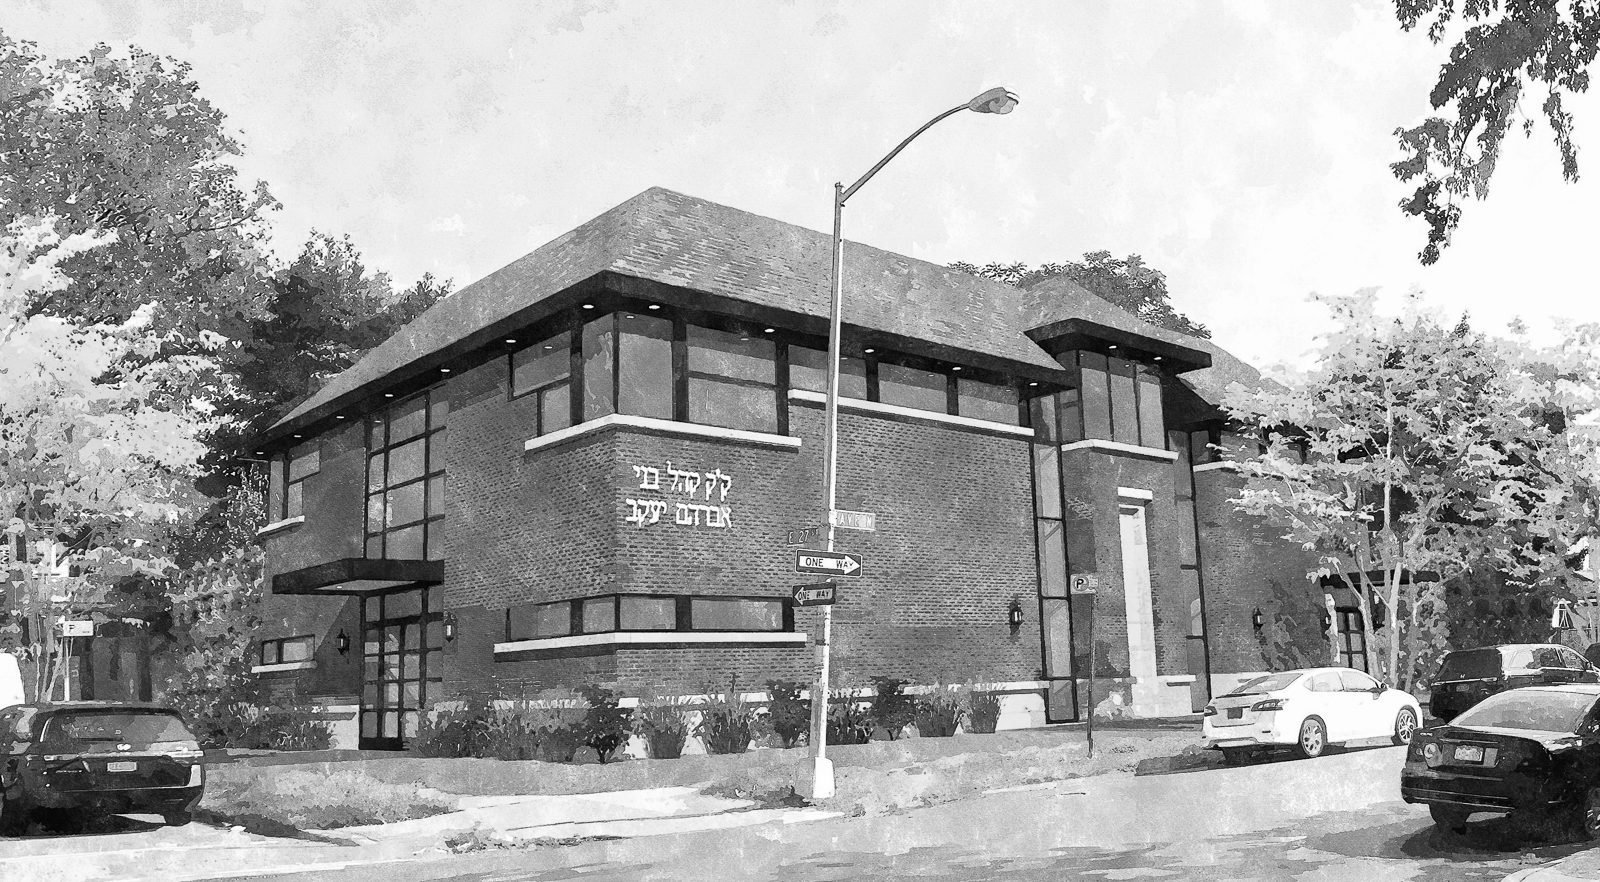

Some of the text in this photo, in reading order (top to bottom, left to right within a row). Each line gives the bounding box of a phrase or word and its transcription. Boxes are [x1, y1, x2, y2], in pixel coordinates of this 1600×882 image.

[632, 465, 660, 490] בני
[666, 460, 701, 499] קהל
[625, 497, 732, 528] אברהם יעקב
[839, 512, 860, 527] AVE
[788, 531, 794, 544] E
[799, 529, 809, 543] 27
[805, 557, 854, 569] ONE WAY
[797, 589, 830, 601] ONE WAY
